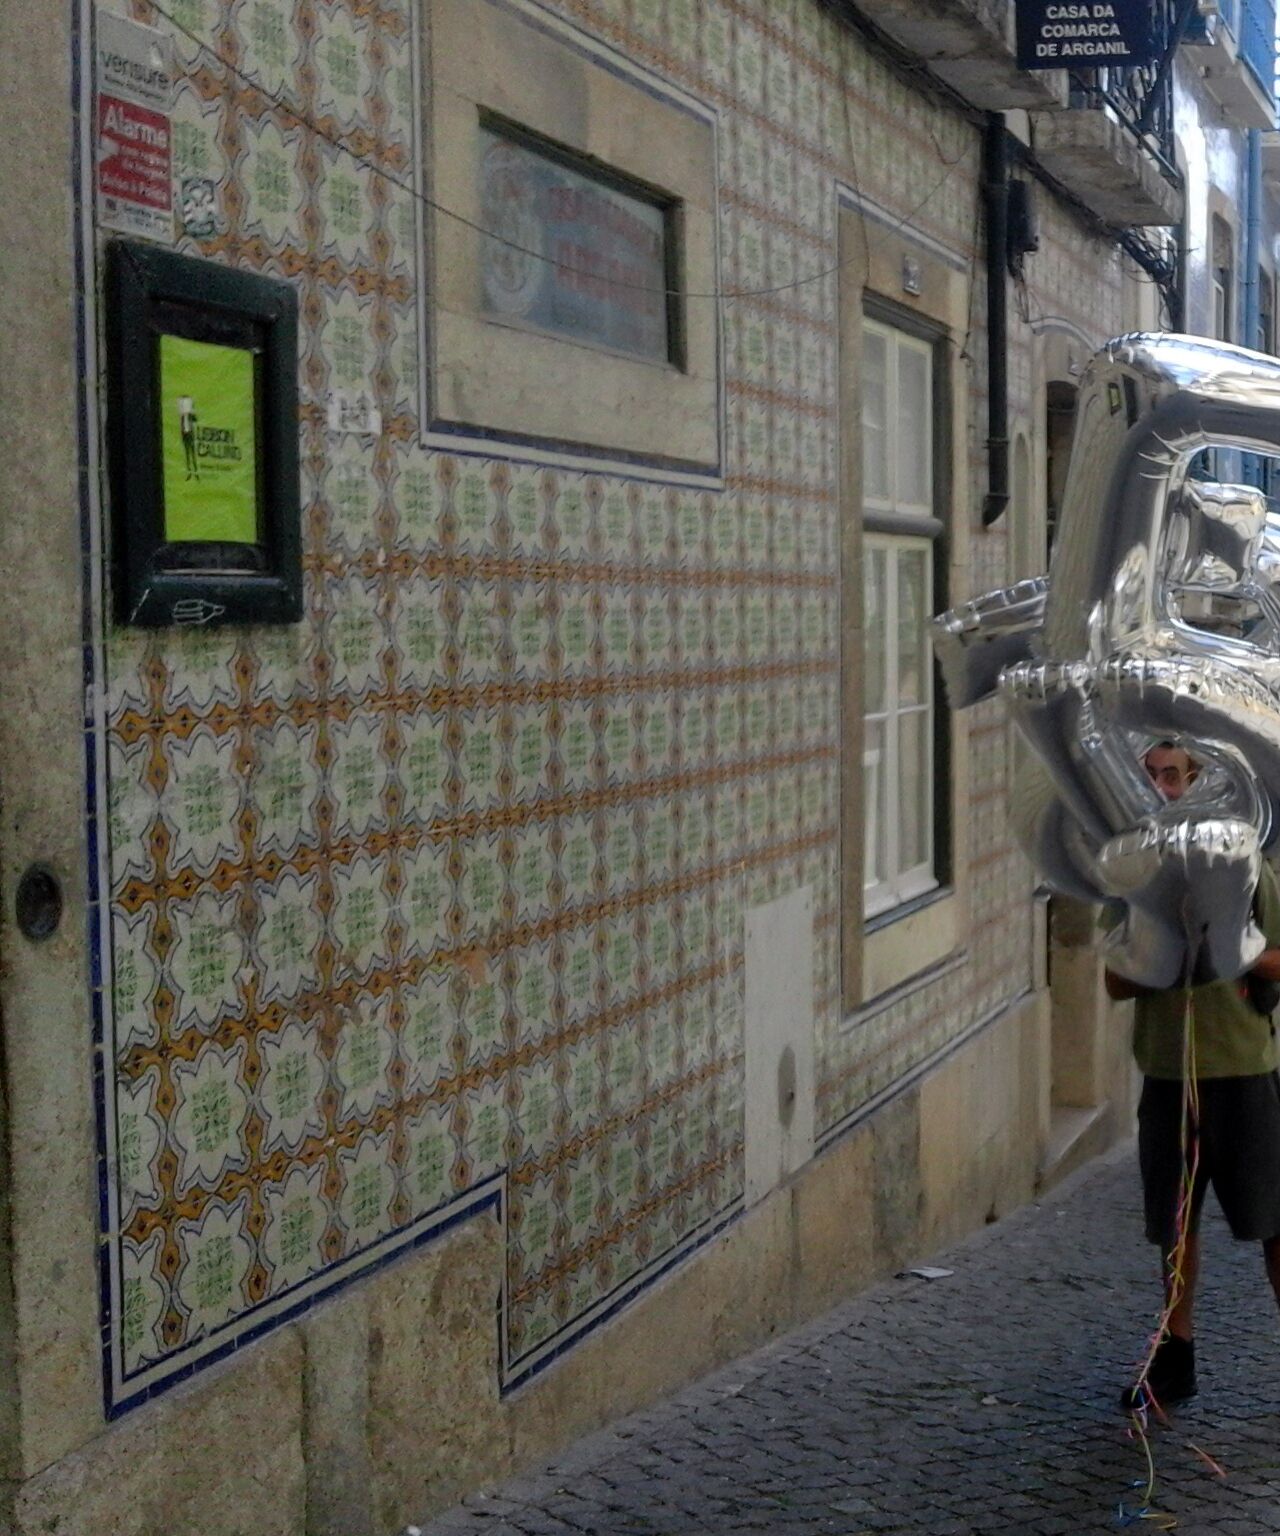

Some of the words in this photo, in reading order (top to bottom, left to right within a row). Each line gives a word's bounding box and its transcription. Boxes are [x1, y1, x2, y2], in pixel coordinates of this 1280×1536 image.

[1046, 5, 1090, 19] CASA
[1093, 4, 1115, 18] DA
[1041, 23, 1121, 38] COMARCA
[1035, 43, 1058, 57] DE
[1061, 41, 1131, 56] ARGANIL
